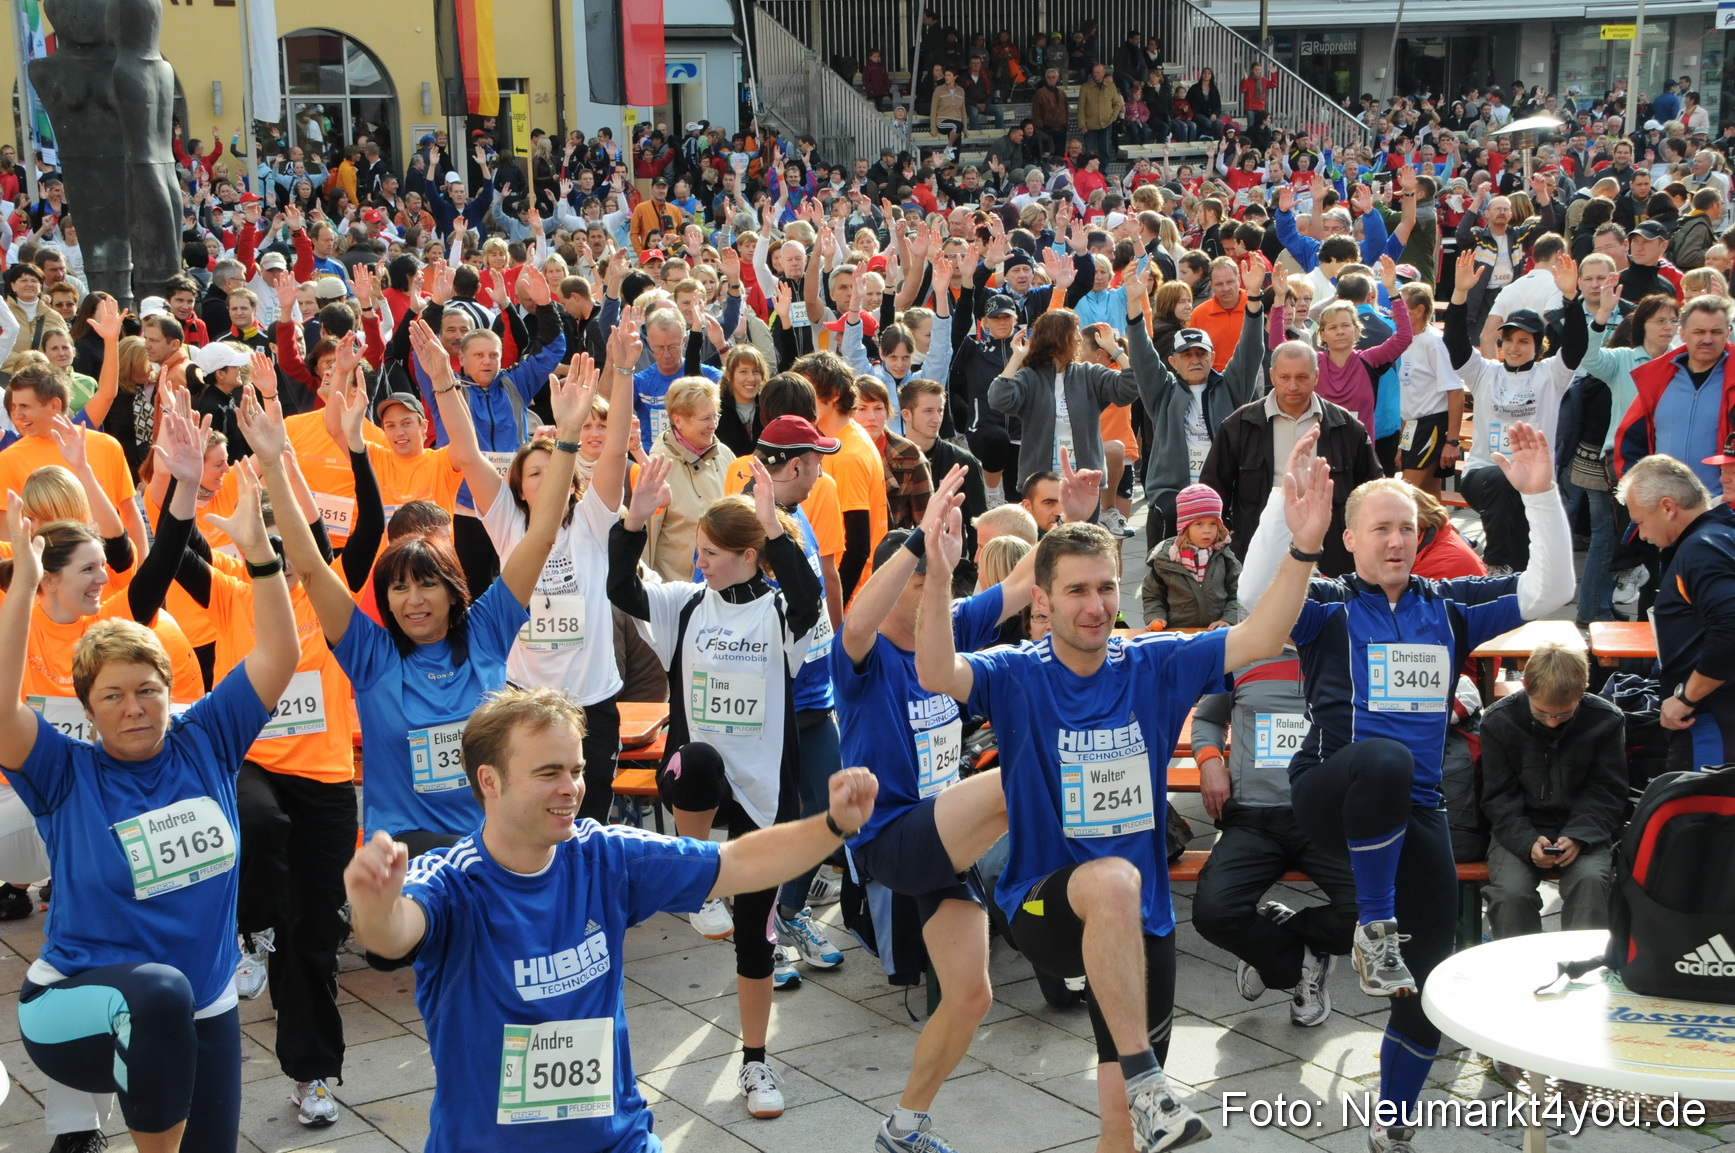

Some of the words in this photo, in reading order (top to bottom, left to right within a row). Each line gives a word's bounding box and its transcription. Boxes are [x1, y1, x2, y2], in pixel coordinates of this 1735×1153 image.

[1313, 41, 1357, 55] Rupprecht
[535, 92, 550, 104] 24
[489, 455, 511, 464] Matthias
[536, 617, 579, 633] 5158
[705, 637, 769, 653] Fischer
[712, 653, 768, 663] Automobile
[1392, 650, 1437, 663] Christian
[710, 677, 730, 690] Tina
[1393, 670, 1441, 688] 3404
[710, 697, 758, 716] 5107
[1276, 718, 1305, 729] Roland
[933, 735, 947, 748] Max
[1058, 720, 1144, 752] HUBER
[936, 744, 959, 771] 2542
[1077, 743, 1144, 761] TECHNOLOGY
[1090, 769, 1126, 784] Walter
[1070, 792, 1076, 803] B
[1093, 785, 1142, 811] 2541
[148, 810, 197, 835] Andrea
[1121, 818, 1153, 829] PFLEIDERER
[159, 826, 224, 864] 5163
[130, 849, 140, 862] S
[513, 930, 610, 987] HUBER
[540, 958, 610, 996] TECHNOLOGY
[531, 1030, 574, 1051] Andre
[505, 1063, 513, 1078] S
[533, 1058, 602, 1090] 5083
[569, 1101, 611, 1113] PFLEIDERER
